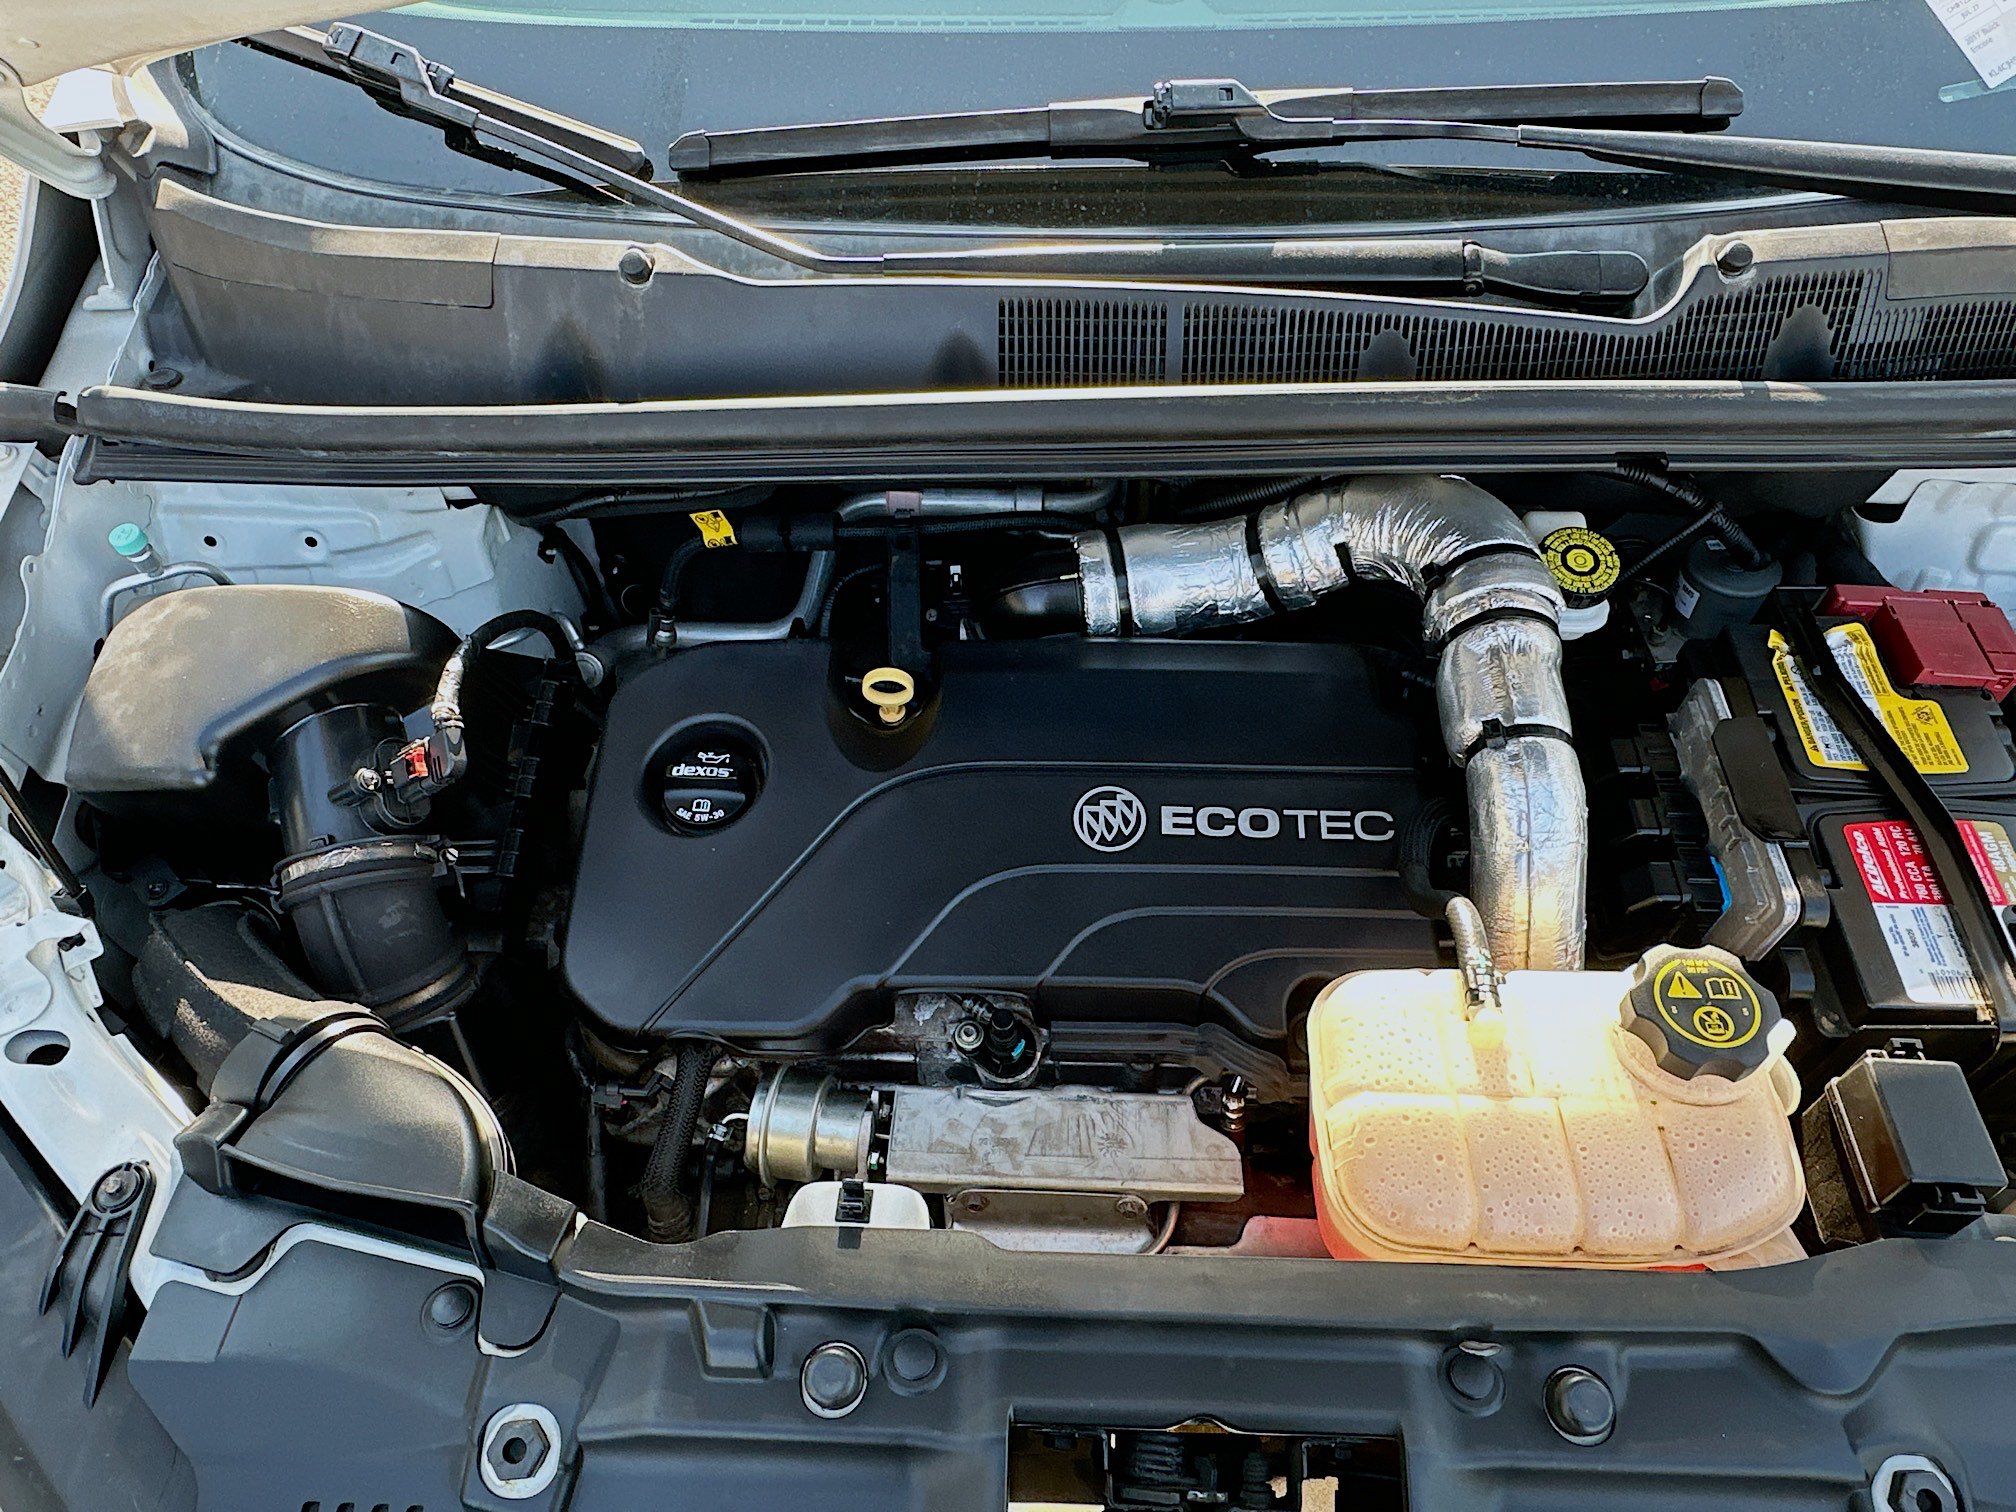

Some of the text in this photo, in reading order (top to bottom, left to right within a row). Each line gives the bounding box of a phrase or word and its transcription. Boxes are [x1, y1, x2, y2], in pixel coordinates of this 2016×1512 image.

[1965, 21, 2001, 46] 2017 Buick
[671, 763, 734, 778] dexos
[676, 808, 725, 822] SAE 5W-30
[1161, 805, 1395, 841] ECOTEC
[1870, 826, 1888, 848] AGM
[1887, 825, 1904, 839] RC
[1894, 839, 1912, 856] 120
[1976, 831, 2009, 872] 48AGM
[1851, 830, 1888, 897] ACDelco
[1878, 848, 1910, 899] Professional
[1903, 860, 1923, 881] CCA
[1912, 882, 1930, 900] 760
